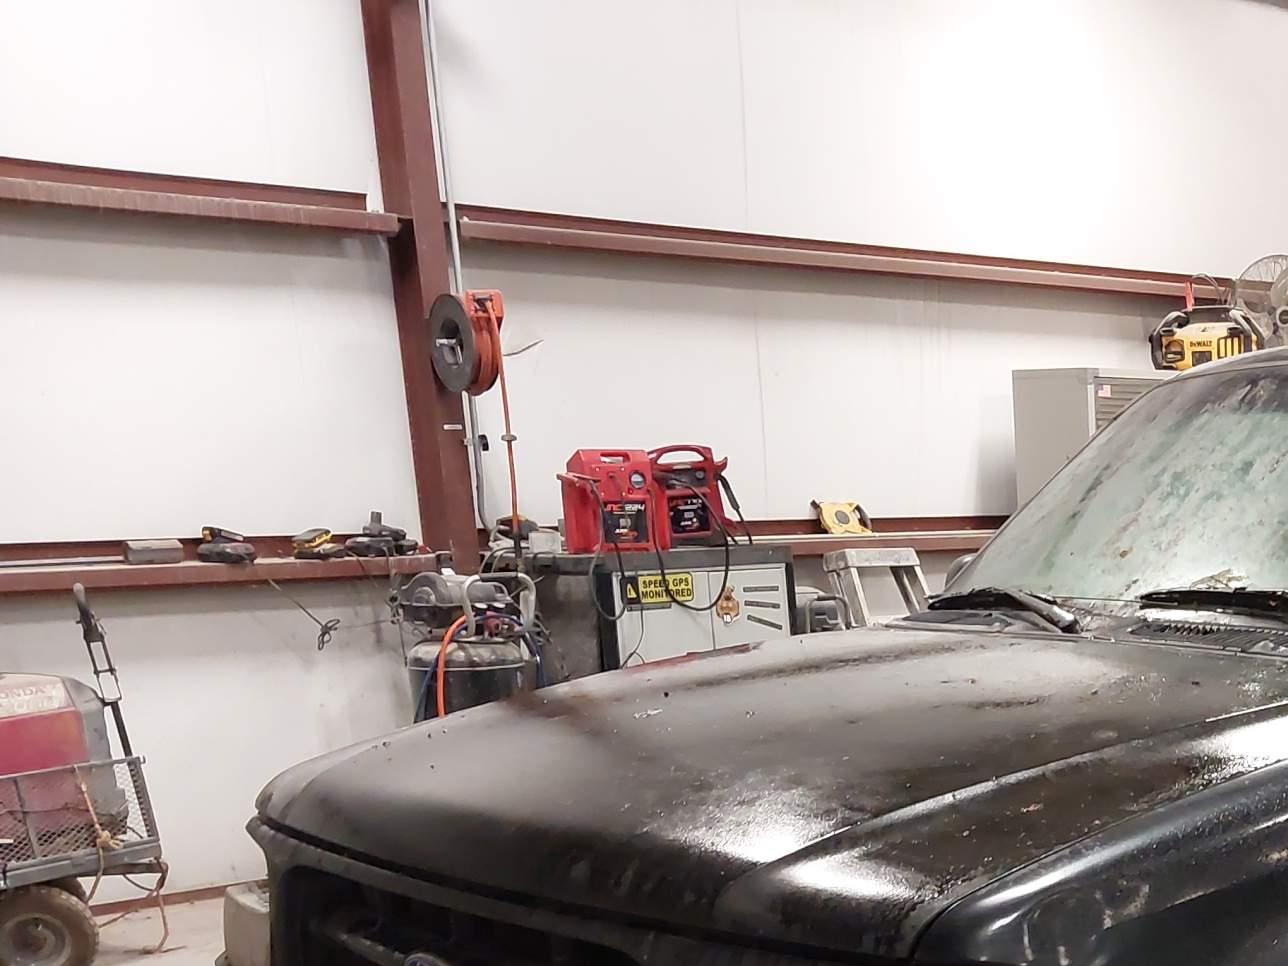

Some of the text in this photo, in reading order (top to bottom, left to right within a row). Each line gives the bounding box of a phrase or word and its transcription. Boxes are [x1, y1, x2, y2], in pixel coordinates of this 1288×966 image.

[624, 503, 646, 511] 224
[672, 577, 690, 587] GPS
[641, 587, 692, 600] MONITORED
